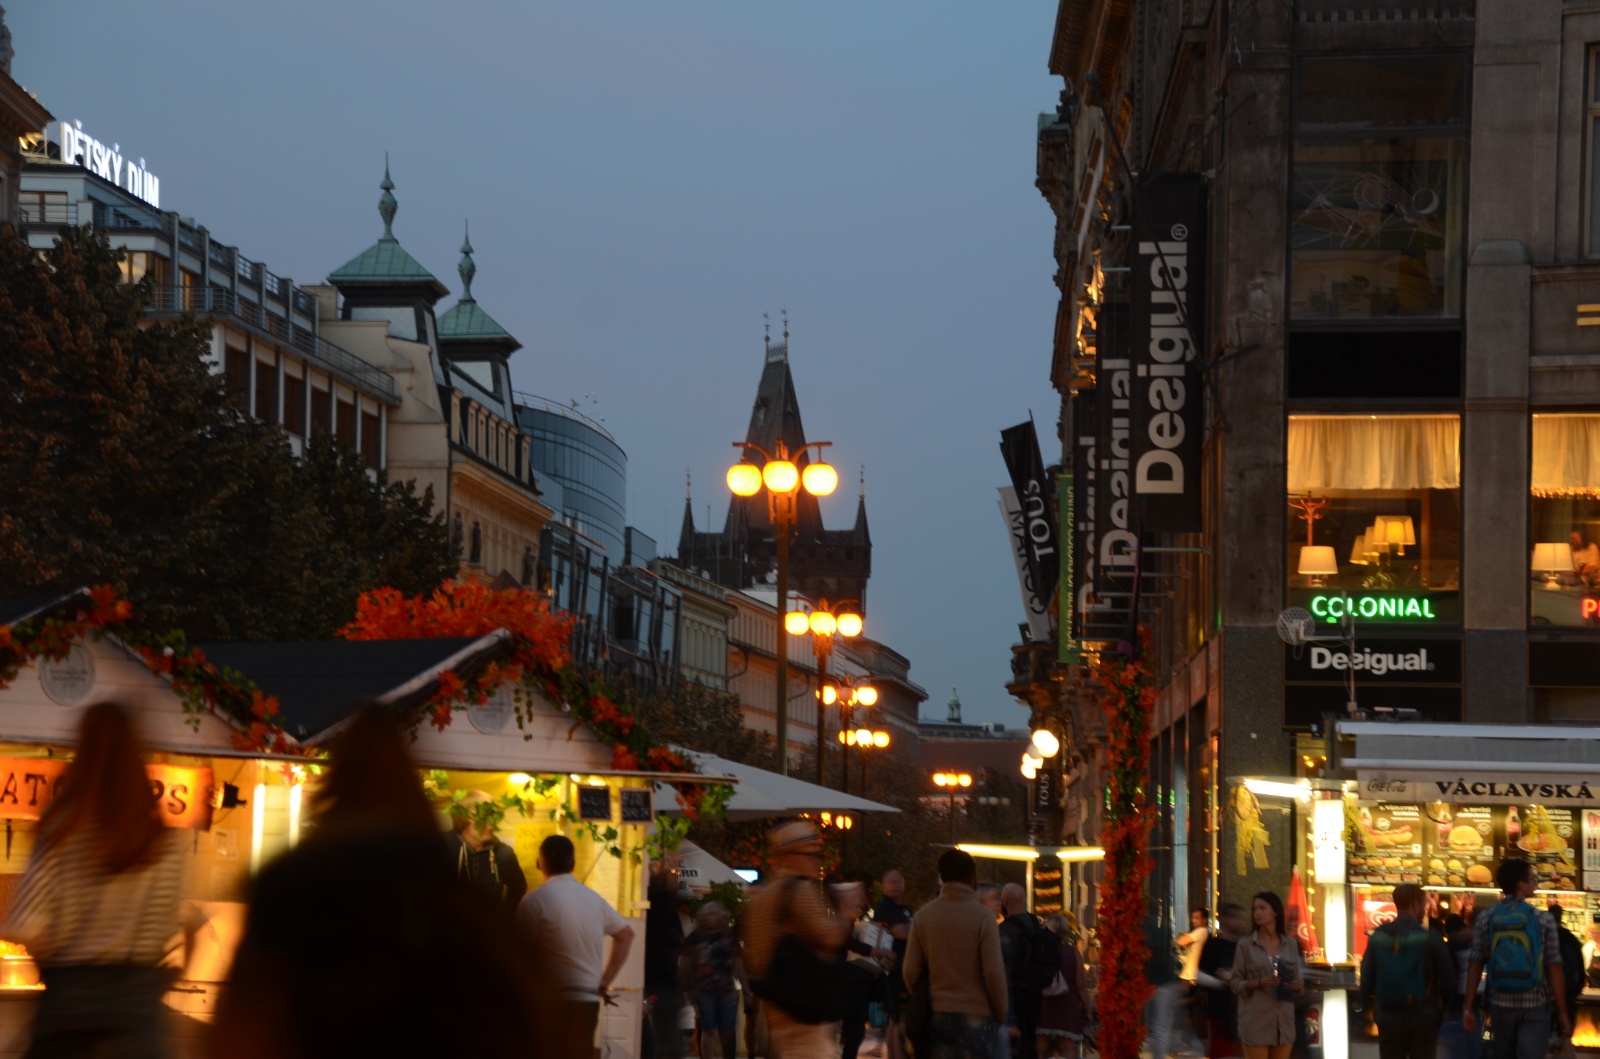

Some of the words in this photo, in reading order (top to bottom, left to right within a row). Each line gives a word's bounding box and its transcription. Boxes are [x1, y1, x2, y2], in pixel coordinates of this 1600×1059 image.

[127, 156, 159, 208] DŮM
[1022, 478, 1055, 562] TOUS
[1311, 595, 1436, 618] COLONIAL
[1039, 773, 1050, 807] TOUS
[1435, 777, 1595, 799] VÁCLAVSKÁ
